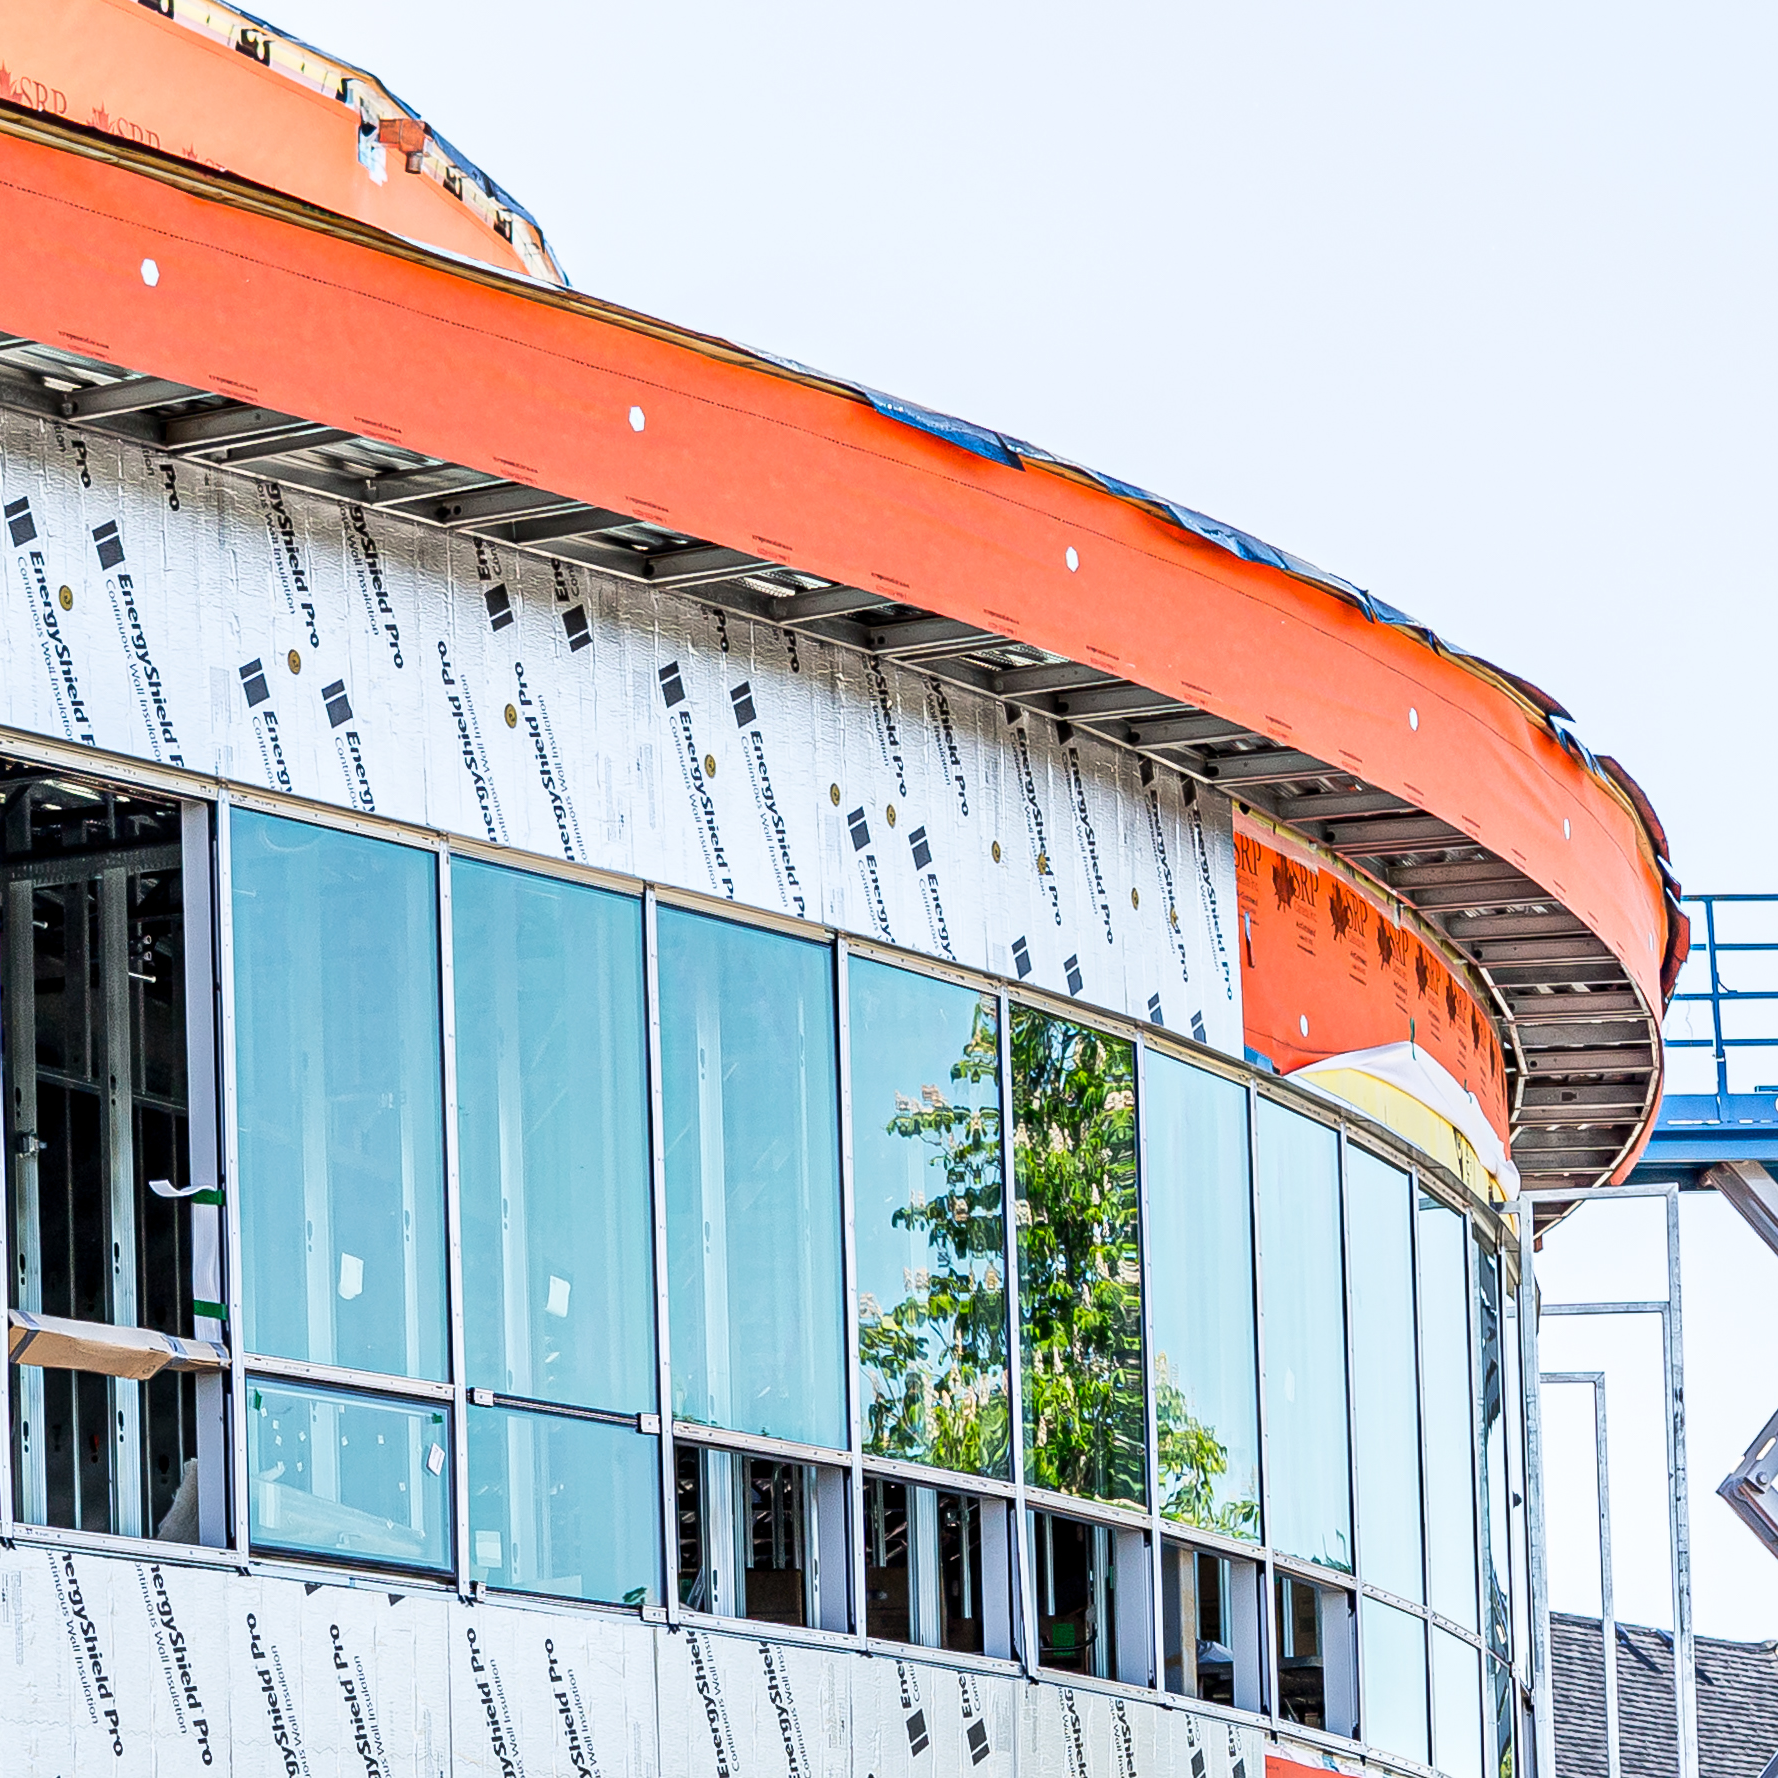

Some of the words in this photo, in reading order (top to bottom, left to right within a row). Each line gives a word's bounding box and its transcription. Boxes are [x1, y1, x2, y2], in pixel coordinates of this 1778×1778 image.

[18, 555, 49, 644] Continuous
[107, 579, 135, 662] Continuous
[29, 551, 89, 739] EnergyShield
[118, 574, 180, 759] EnergyShield
[438, 641, 455, 686] Pro
[460, 674, 481, 739] Insulation
[538, 694, 558, 758] Insulation
[670, 716, 691, 791] Continuous
[698, 827, 717, 890] Insulation
[679, 711, 727, 869] EnergyShield
[751, 731, 800, 888] EnergyShield
[893, 756, 907, 798] Pro
[741, 736, 763, 809] Continuous
[768, 845, 788, 908] Insulation
[1068, 748, 1106, 896] EnergyShield
[1101, 904, 1113, 944] Pro
[1294, 859, 1318, 907] SRP
[1346, 890, 1368, 937] SRP
[1178, 944, 1188, 983] Pro
[246, 1612, 266, 1662] Pro
[466, 1627, 486, 1674] Pro
[270, 1644, 296, 1711] Insulation
[193, 1718, 213, 1767] Pro
